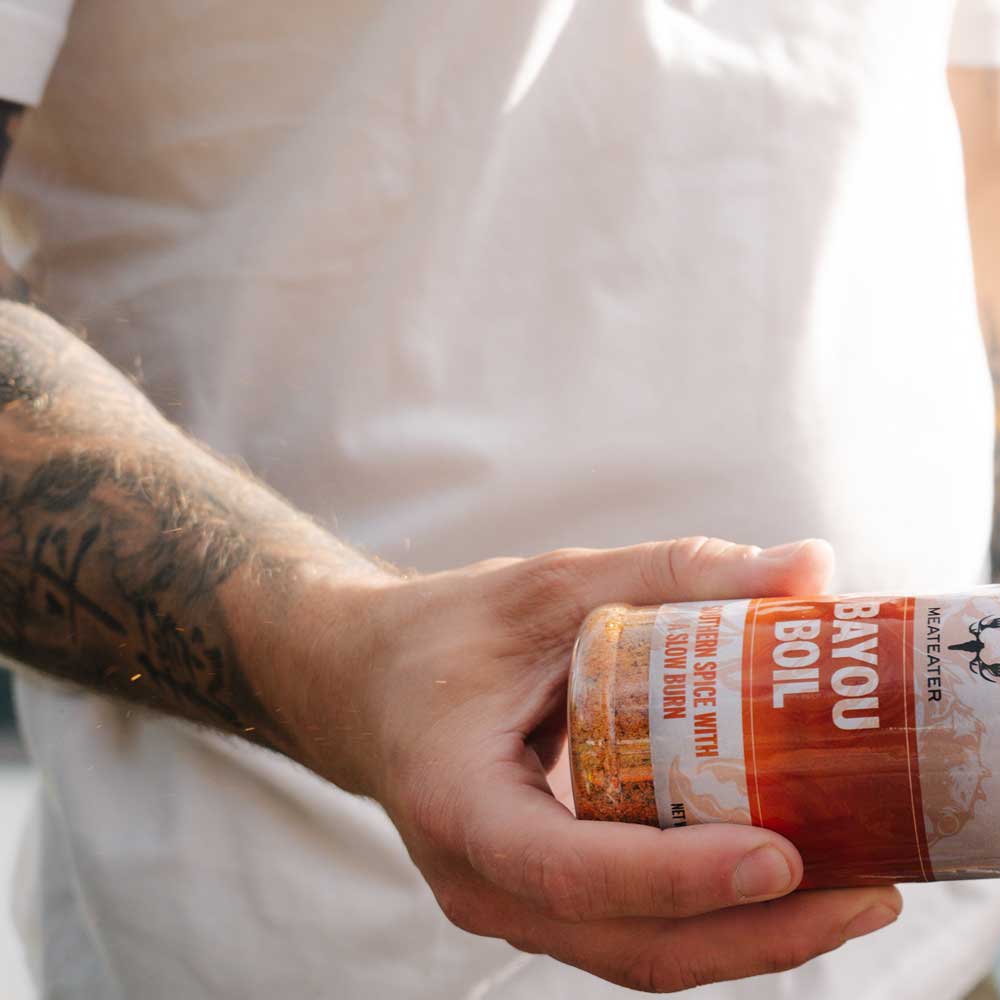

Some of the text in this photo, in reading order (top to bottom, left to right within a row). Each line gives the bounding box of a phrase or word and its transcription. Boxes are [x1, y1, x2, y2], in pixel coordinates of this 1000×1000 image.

[664, 633, 689, 669] SLOW
[771, 619, 821, 709] BOIL
[831, 601, 880, 731] BAYOU
[927, 606, 942, 701] MEATEATER
[663, 674, 687, 720] BURN
[693, 661, 717, 707] SPICE
[694, 711, 719, 758] WITH
[670, 803, 686, 819] NET
